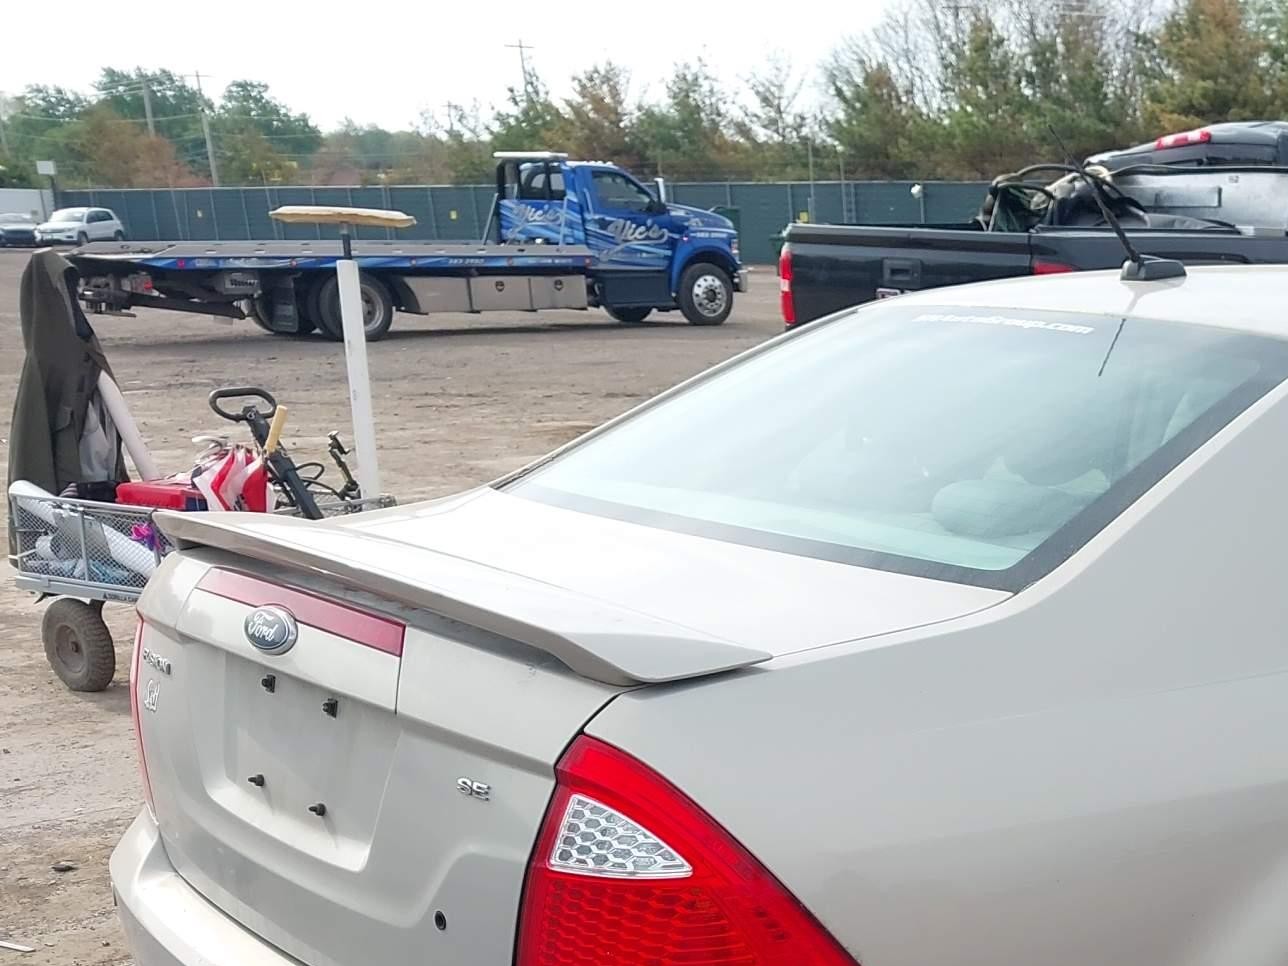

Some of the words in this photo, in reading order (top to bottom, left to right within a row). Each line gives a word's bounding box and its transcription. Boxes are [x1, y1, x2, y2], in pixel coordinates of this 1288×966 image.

[605, 218, 668, 248] Vic's
[247, 610, 279, 641] Ford
[457, 777, 491, 801] SE
